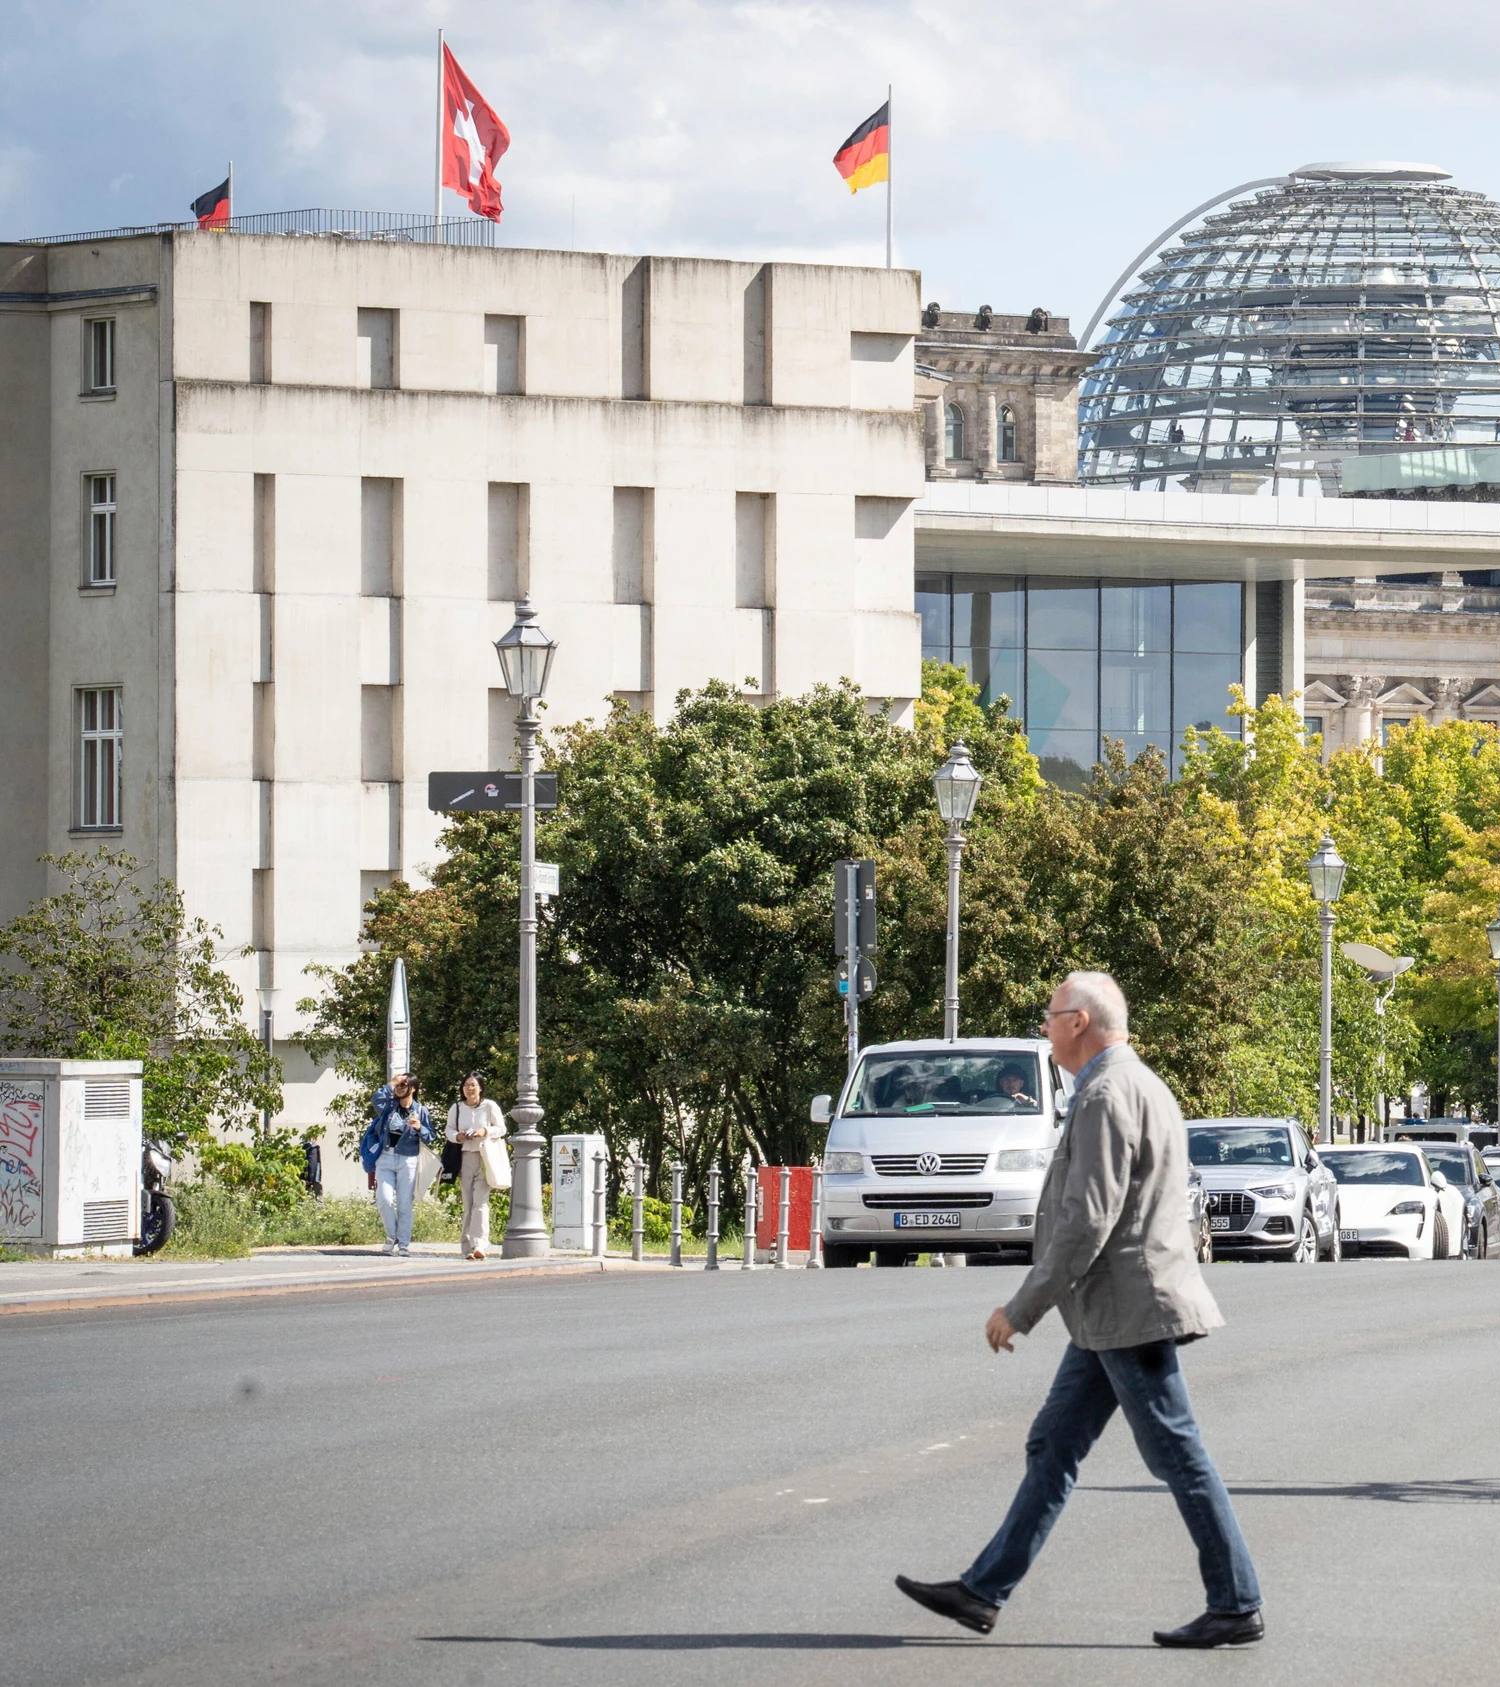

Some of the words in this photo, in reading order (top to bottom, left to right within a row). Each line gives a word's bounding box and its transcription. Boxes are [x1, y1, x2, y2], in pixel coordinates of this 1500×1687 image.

[901, 1214, 909, 1225] B
[915, 1214, 929, 1225] ED
[931, 1214, 959, 1225] 2640
